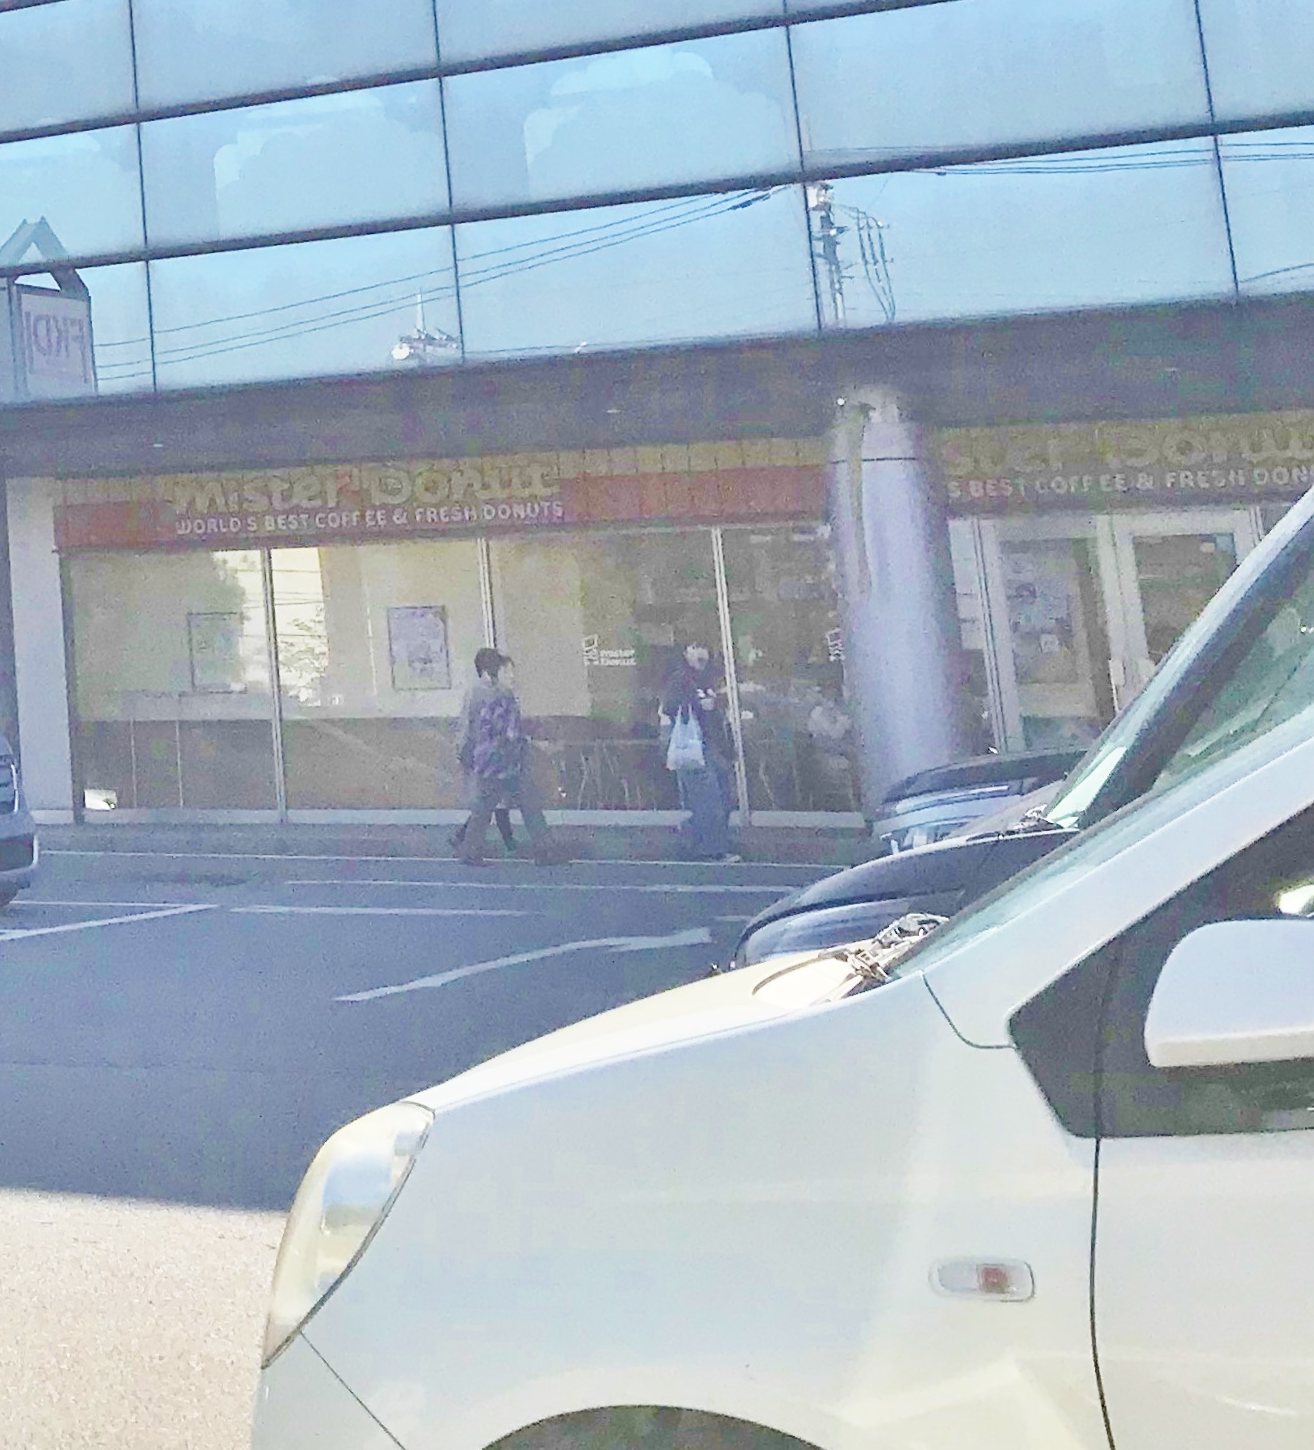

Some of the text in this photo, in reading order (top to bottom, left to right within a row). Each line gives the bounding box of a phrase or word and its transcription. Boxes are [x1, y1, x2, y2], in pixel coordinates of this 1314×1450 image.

[1253, 464, 1314, 486] DON
[264, 513, 309, 531] BEST
[315, 510, 386, 529] COFFEE
[392, 508, 408, 525] &
[415, 505, 477, 524] FRESH
[483, 501, 563, 521] DONUTS
